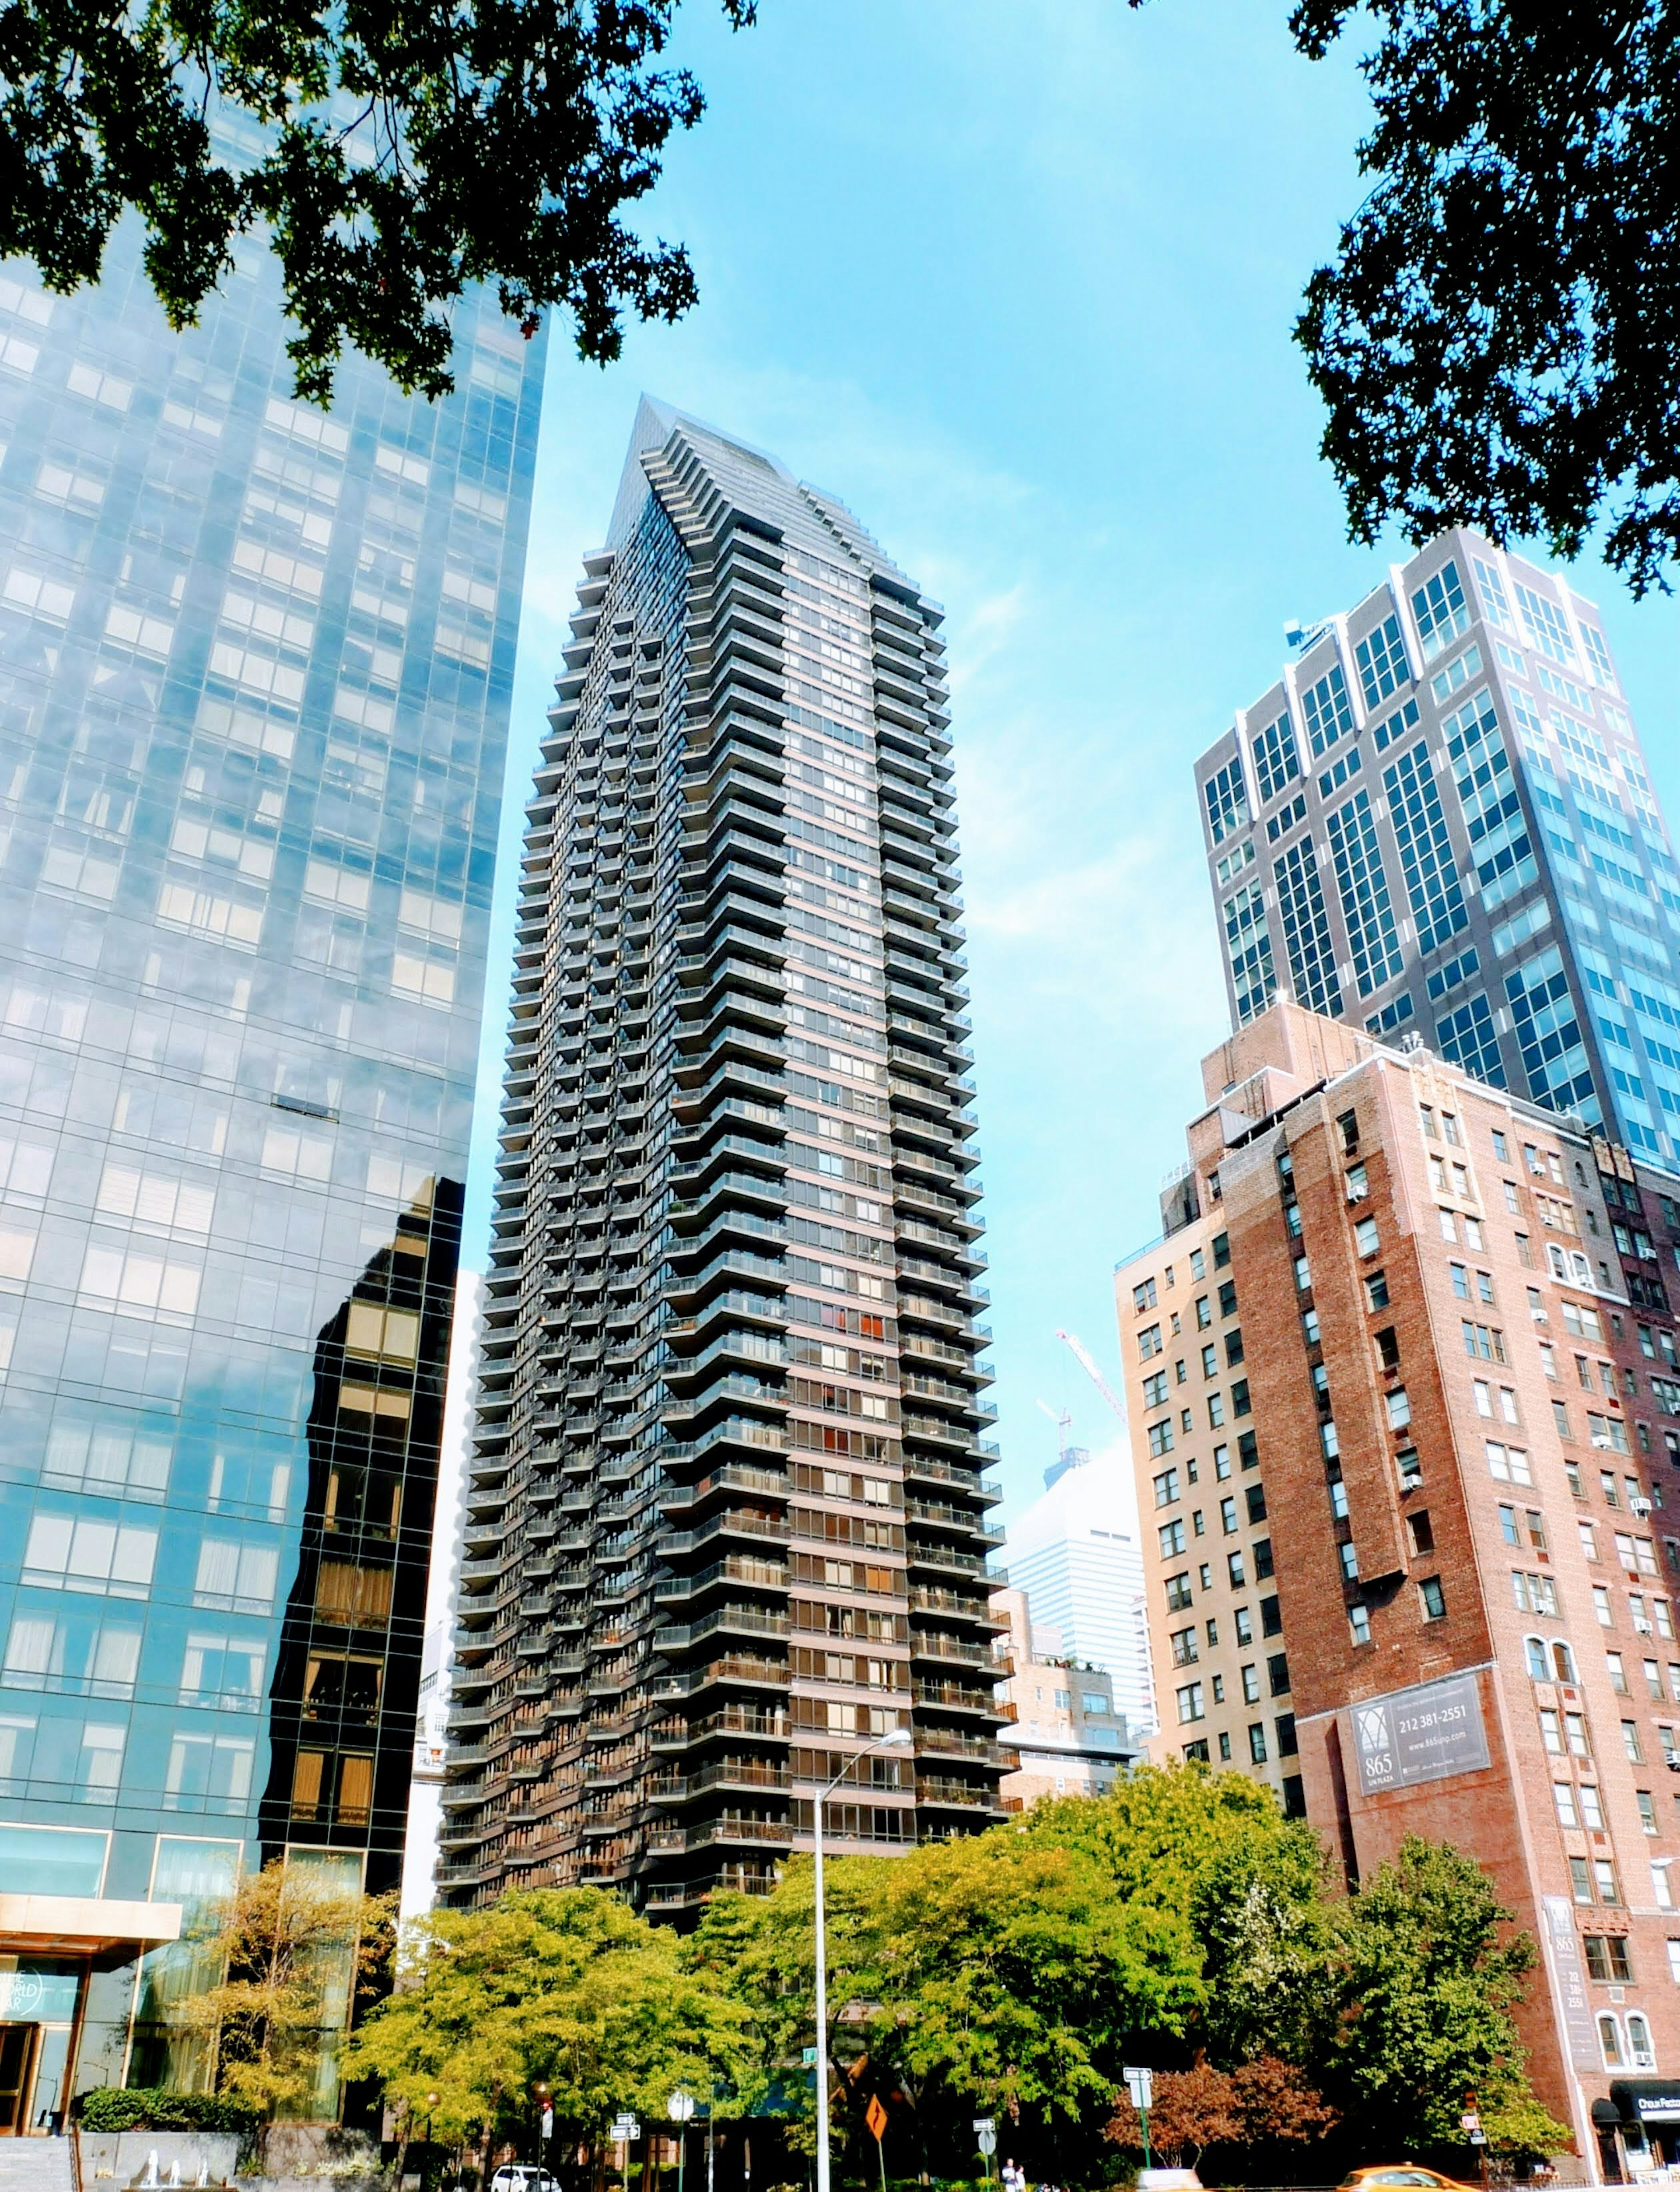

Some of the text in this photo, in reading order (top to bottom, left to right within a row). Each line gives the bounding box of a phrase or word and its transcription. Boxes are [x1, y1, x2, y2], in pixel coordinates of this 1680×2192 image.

[1400, 1705, 1466, 1733] 212 381-2551
[1365, 1754, 1392, 1777] 865
[1556, 1936, 1574, 1952] 865
